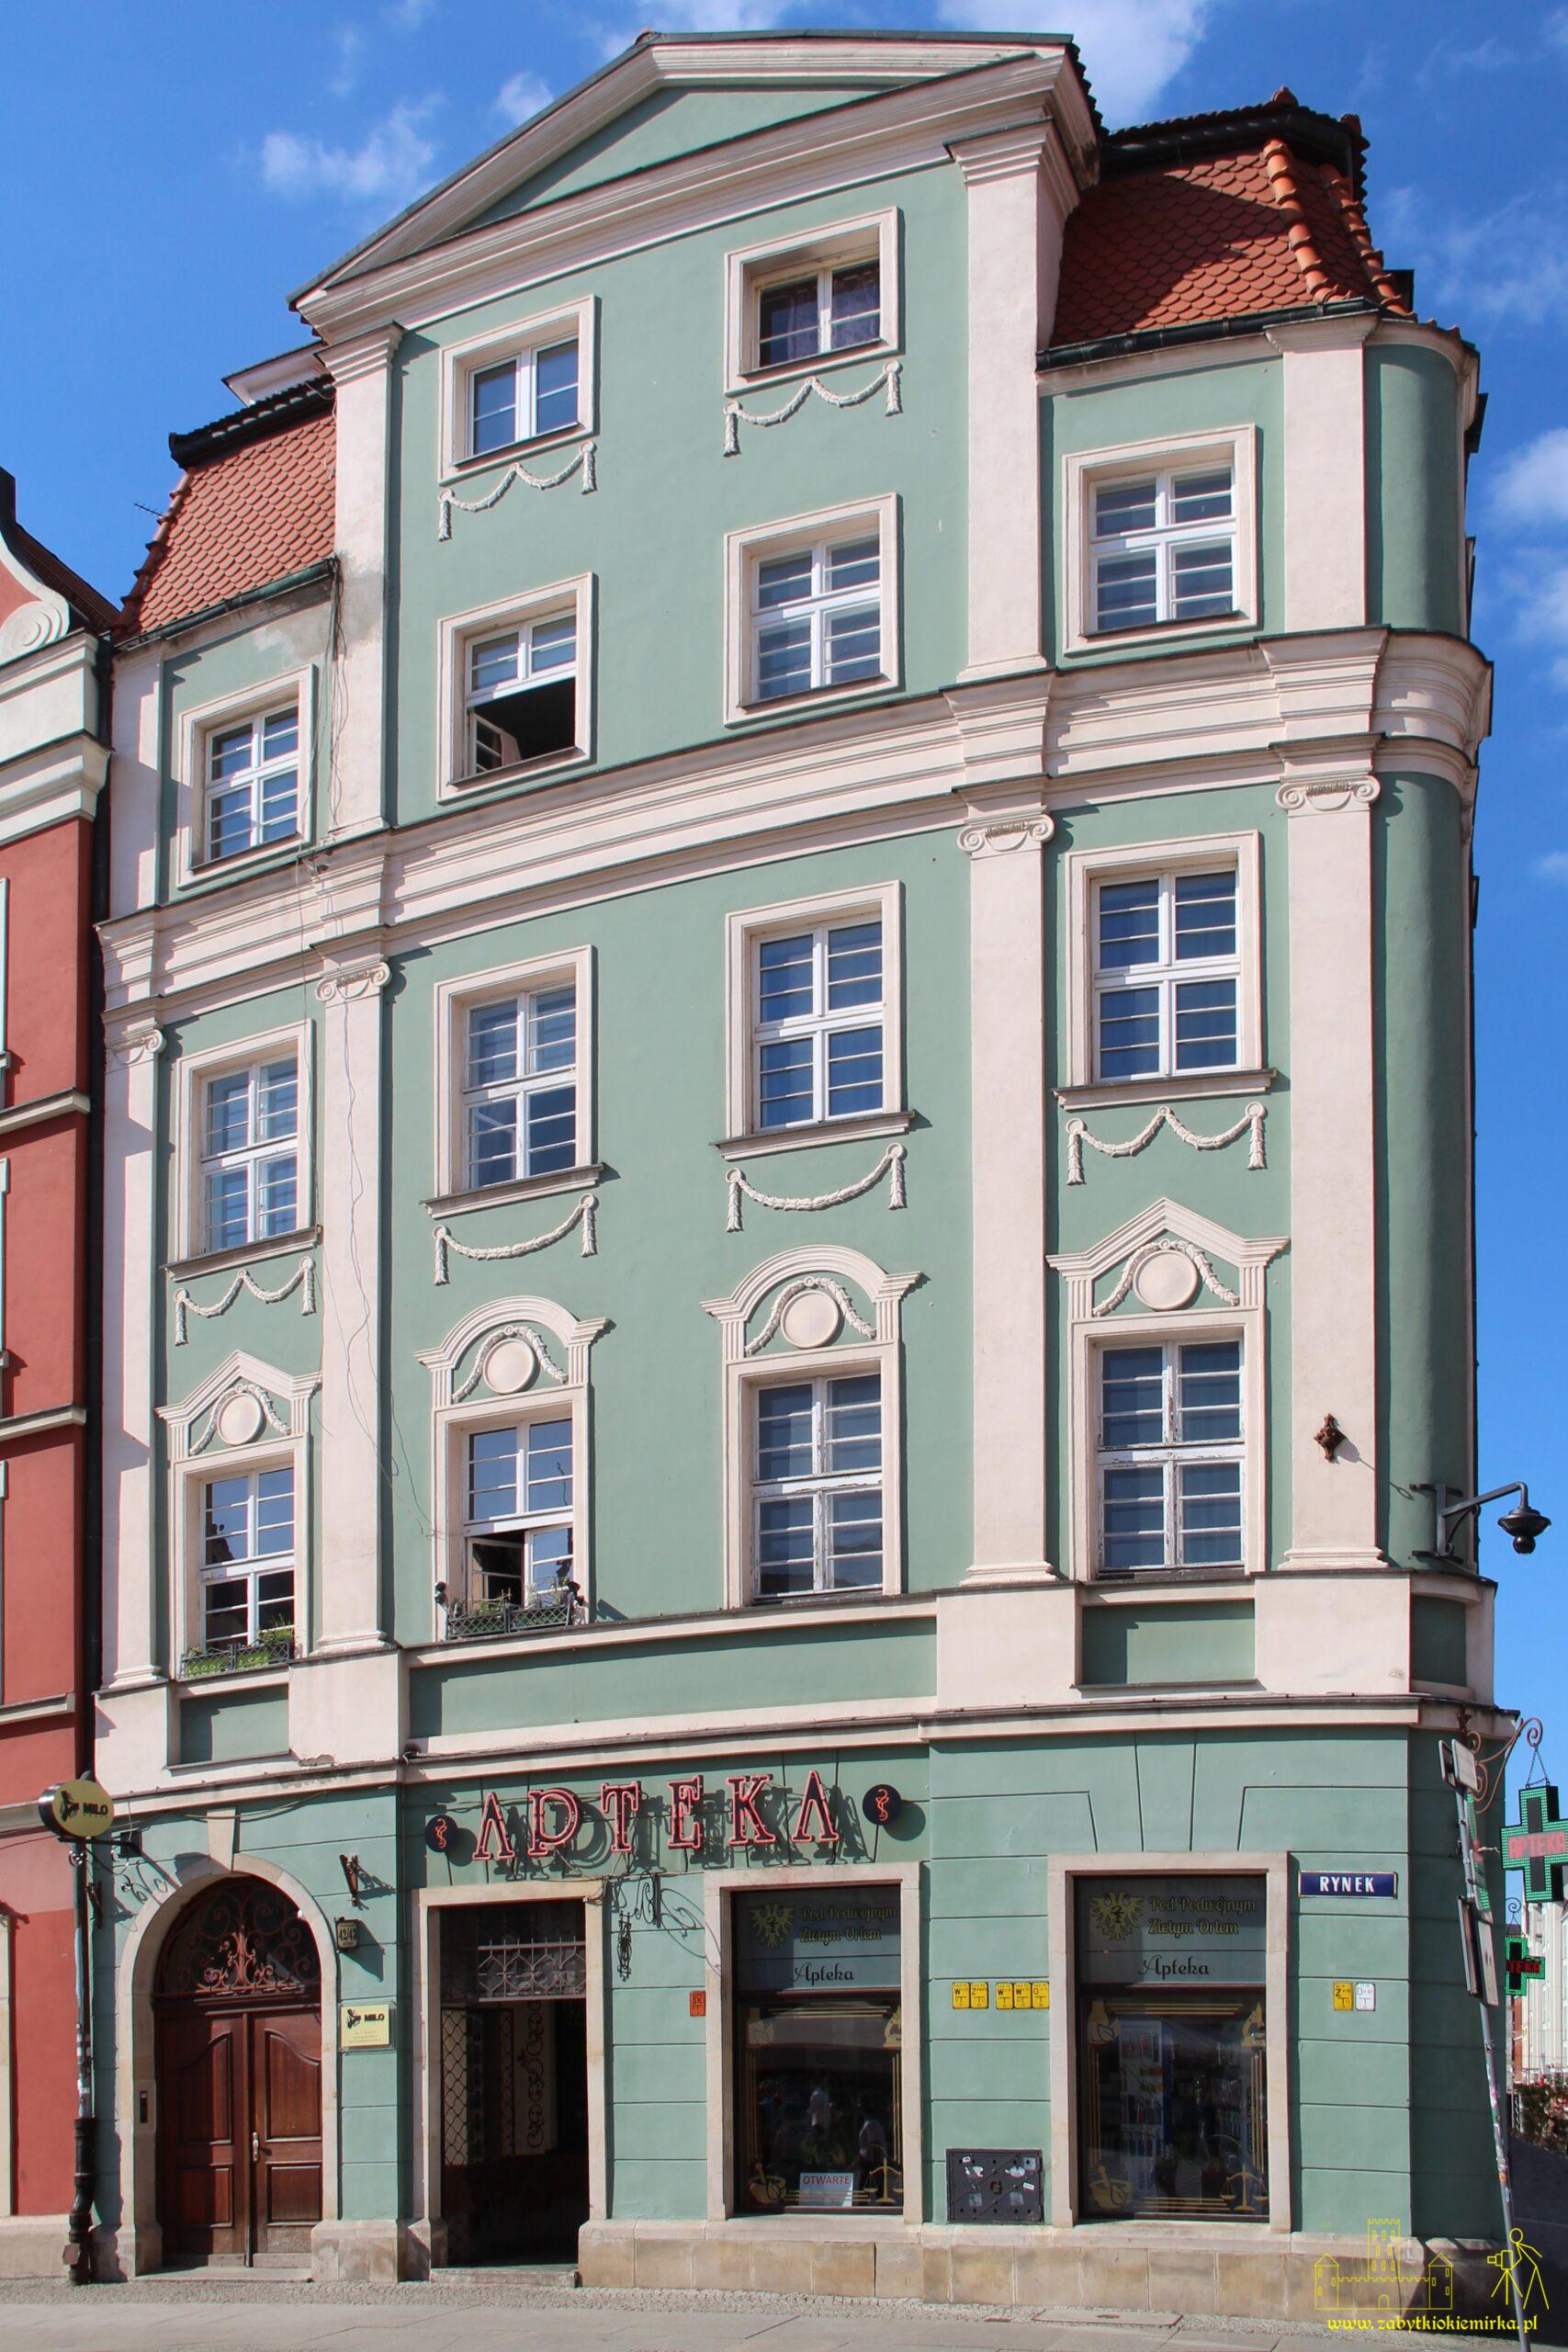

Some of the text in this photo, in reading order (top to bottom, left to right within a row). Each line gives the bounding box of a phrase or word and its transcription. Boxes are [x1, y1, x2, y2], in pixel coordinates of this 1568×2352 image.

[83, 1802, 109, 1815] MILO
[472, 1770, 840, 1860] APTEKA
[1507, 1830, 1566, 1860] APTEKA
[1319, 1875, 1375, 1893] RYNEK
[1148, 1895, 1176, 1912] Pod
[792, 1962, 854, 1986] Apteka
[1138, 1954, 1210, 1980] Apteka
[365, 2013, 385, 2021] MILO
[803, 2175, 851, 2185] OTWARTE
